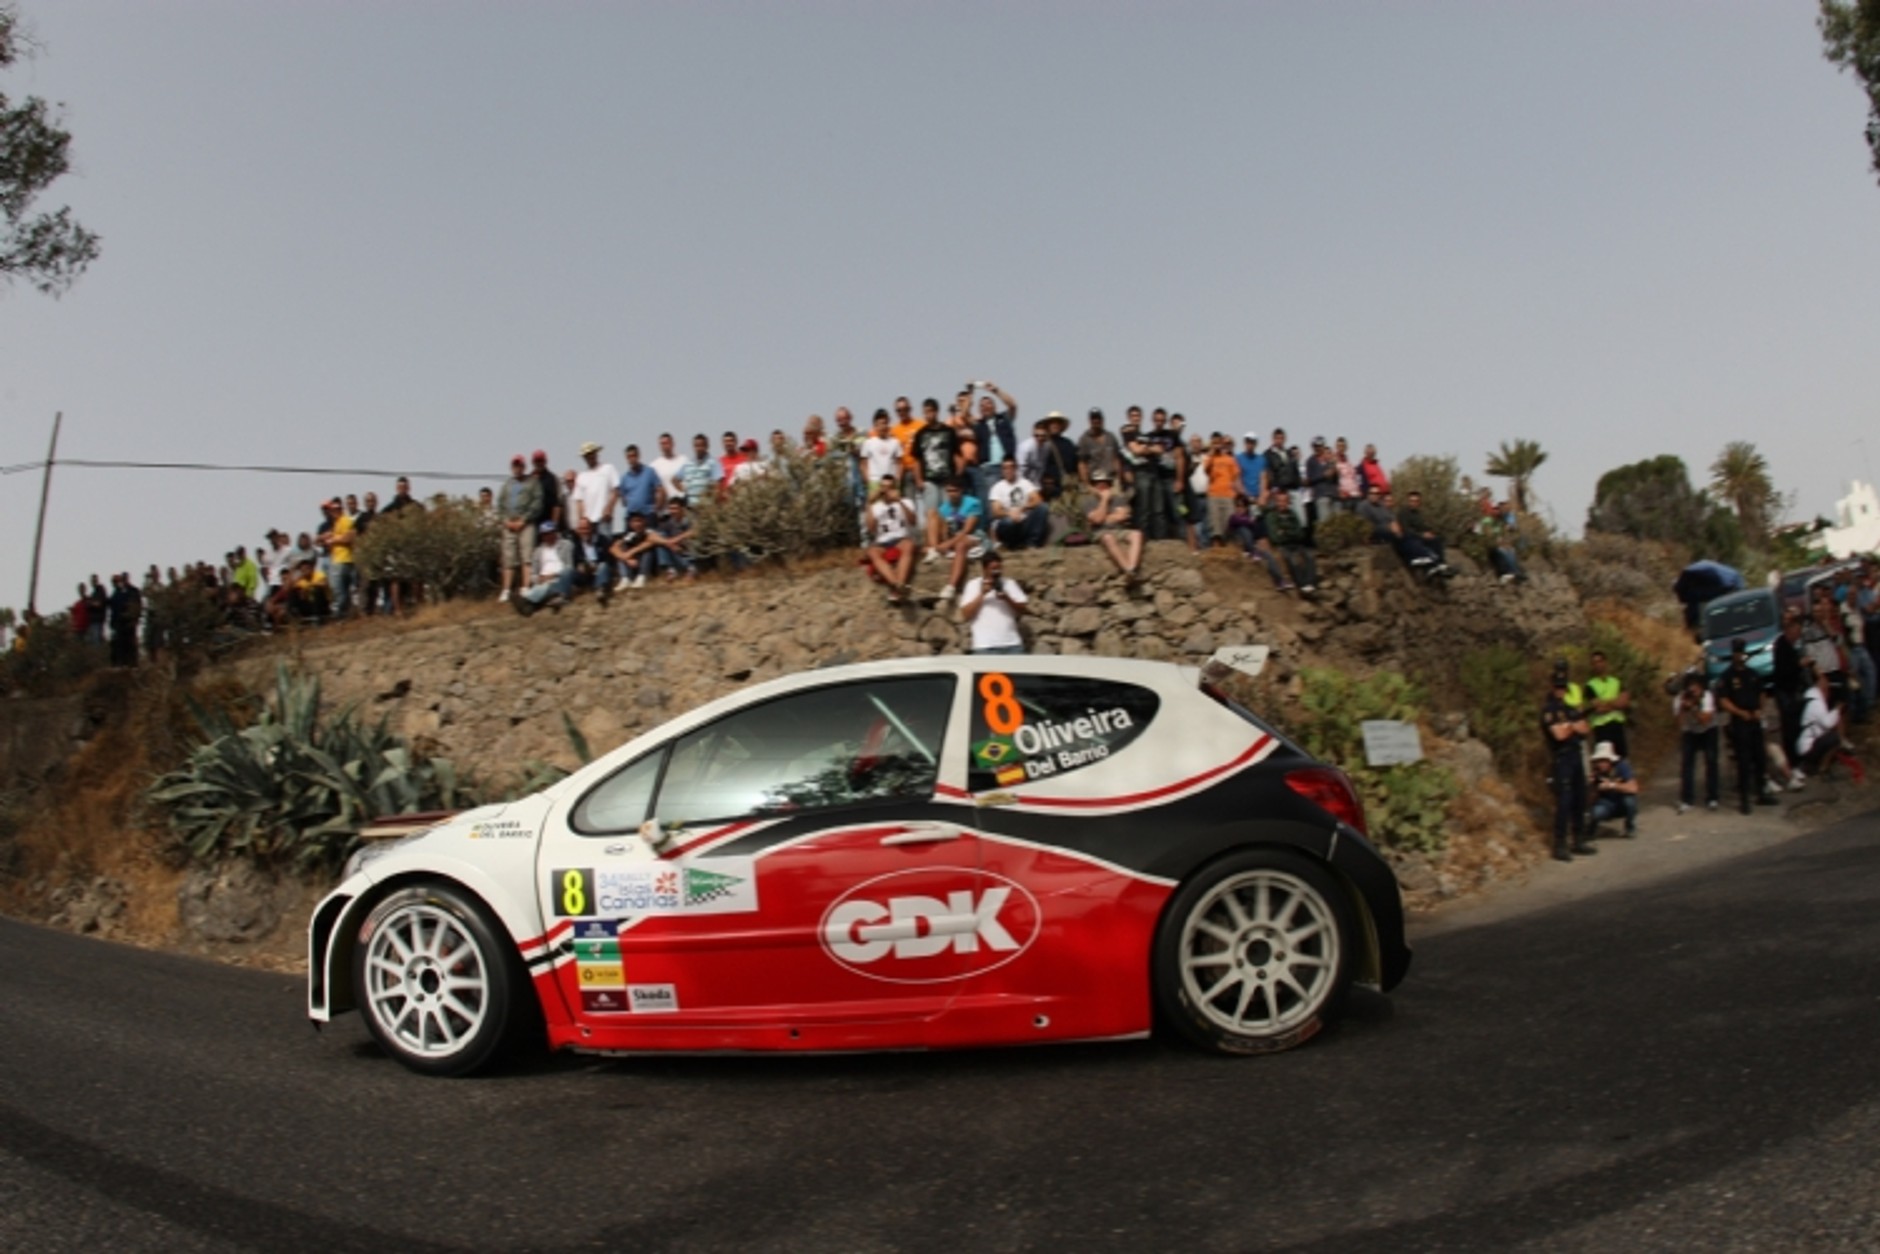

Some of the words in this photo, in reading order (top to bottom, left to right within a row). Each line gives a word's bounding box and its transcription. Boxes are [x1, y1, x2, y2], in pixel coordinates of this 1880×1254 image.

[978, 672, 1024, 735] 8
[1013, 706, 1133, 755] Oliveira
[1025, 759, 1055, 779] Del
[1058, 743, 1109, 768] Barrio
[562, 869, 585, 915] 8
[599, 894, 679, 911] Canarias
[825, 885, 1021, 963] GDK
